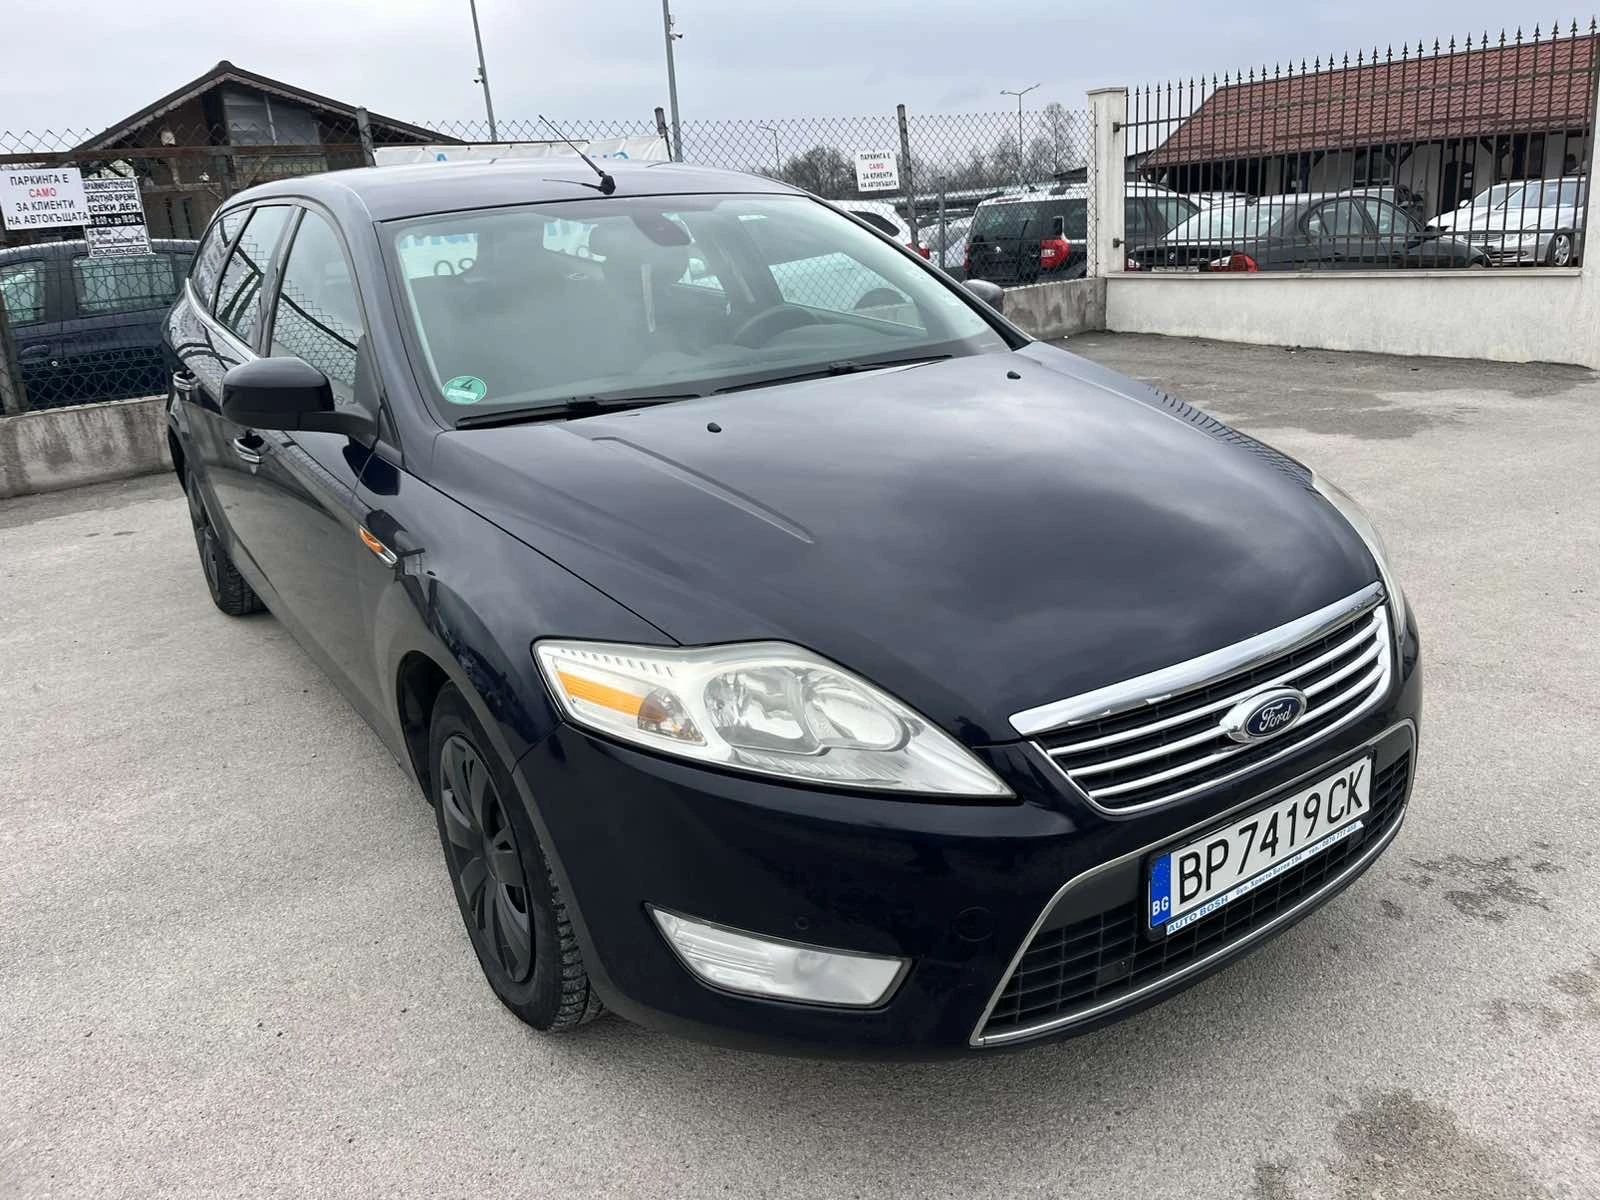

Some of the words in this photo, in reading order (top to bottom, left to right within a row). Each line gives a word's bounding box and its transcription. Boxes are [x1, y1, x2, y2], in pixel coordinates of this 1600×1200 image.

[10, 174, 61, 186] ПАРКИНГА
[62, 173, 70, 184] Е
[29, 187, 57, 198] САМО
[15, 202, 30, 212] ЗА
[31, 199, 75, 211] КЛИЕНТИ
[118, 202, 138, 212] ДЕН
[7, 215, 21, 226] НА
[460, 379, 473, 391] 4
[1259, 702, 1292, 732] Ford
[1152, 895, 1169, 917] BG
[1167, 912, 1198, 934] AUTO
[1199, 895, 1229, 918] BOSH
